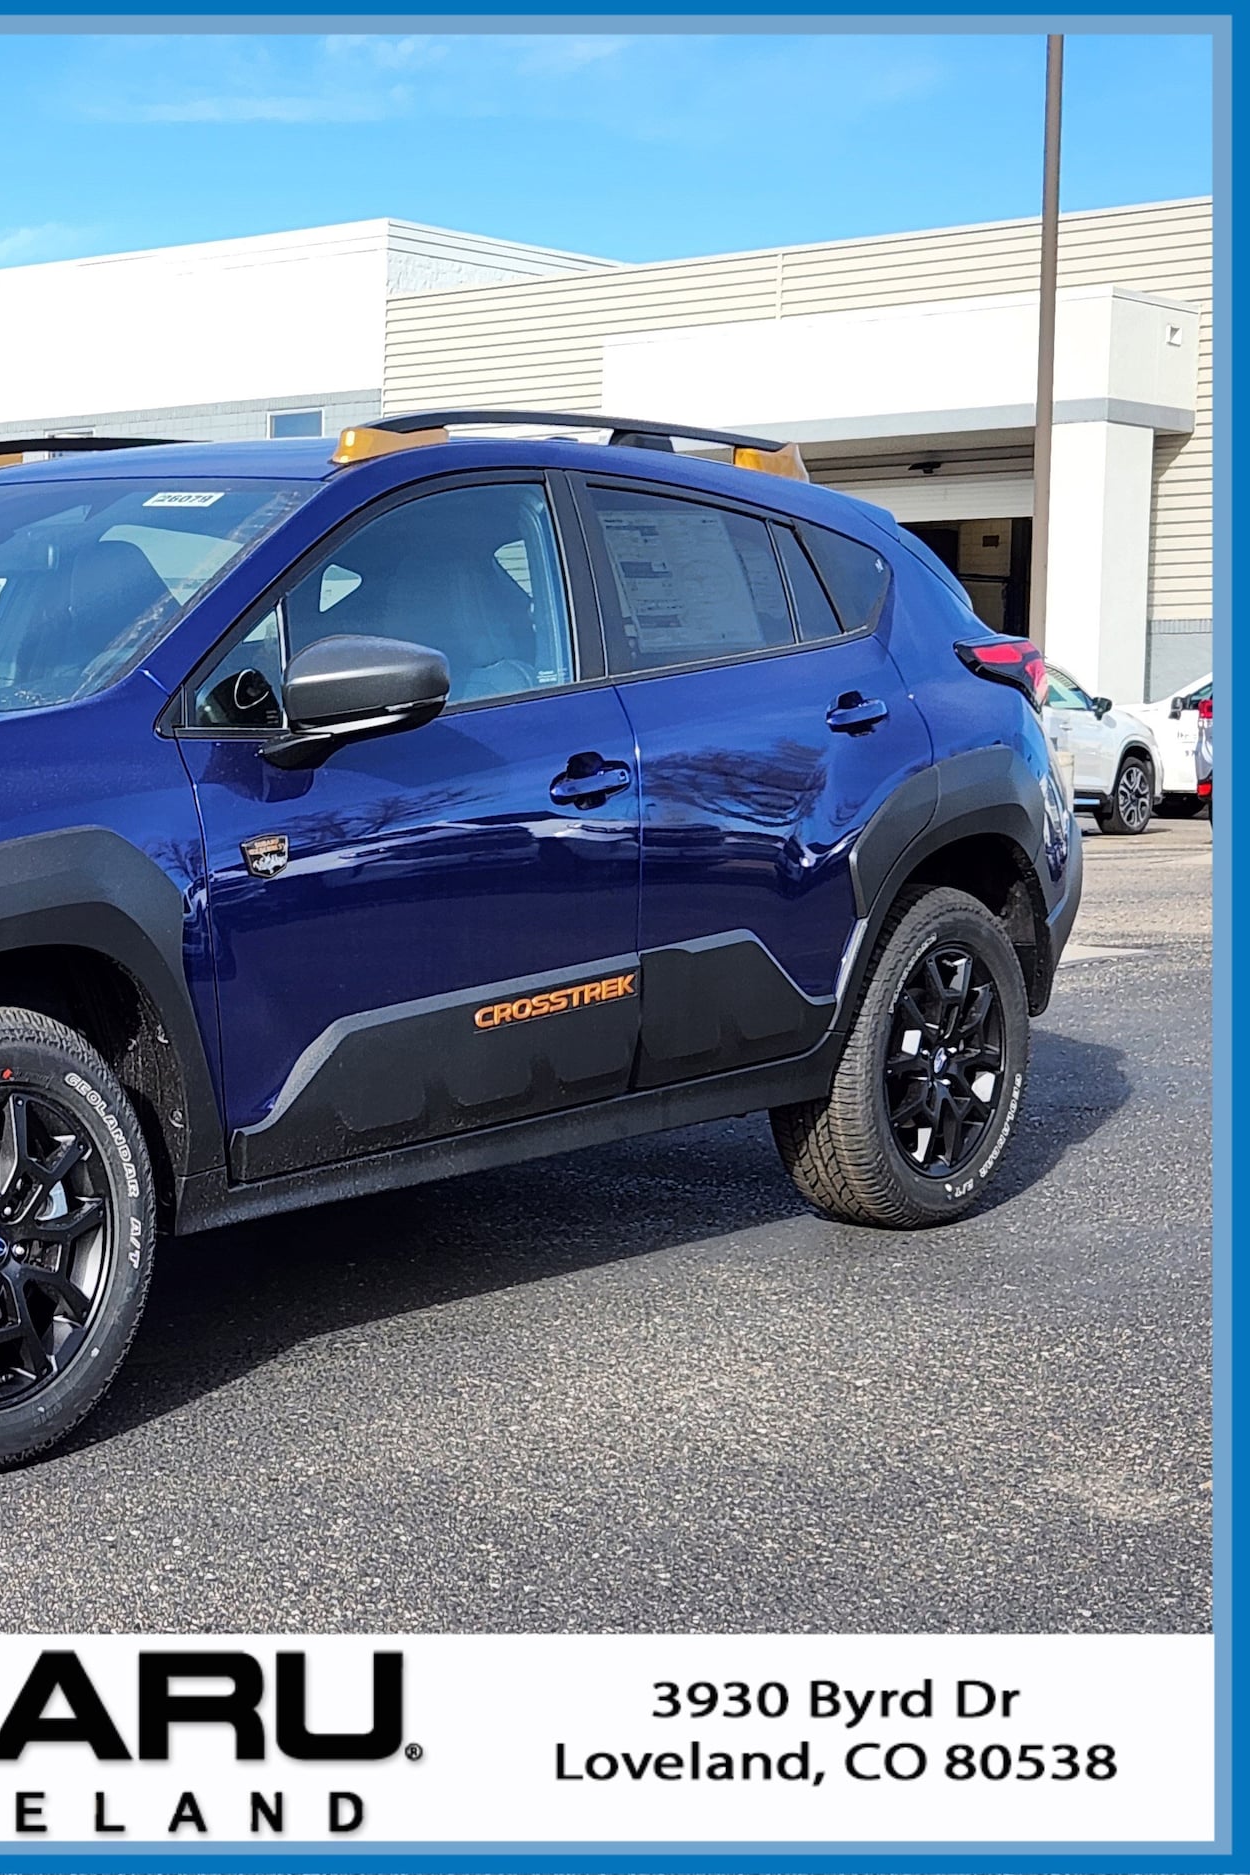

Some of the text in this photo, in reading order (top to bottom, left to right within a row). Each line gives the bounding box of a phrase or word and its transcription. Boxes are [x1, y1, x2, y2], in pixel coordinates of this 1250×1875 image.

[474, 973, 636, 1029] CROSSTREK
[64, 1072, 142, 1270] GEOLANDAR A/T
